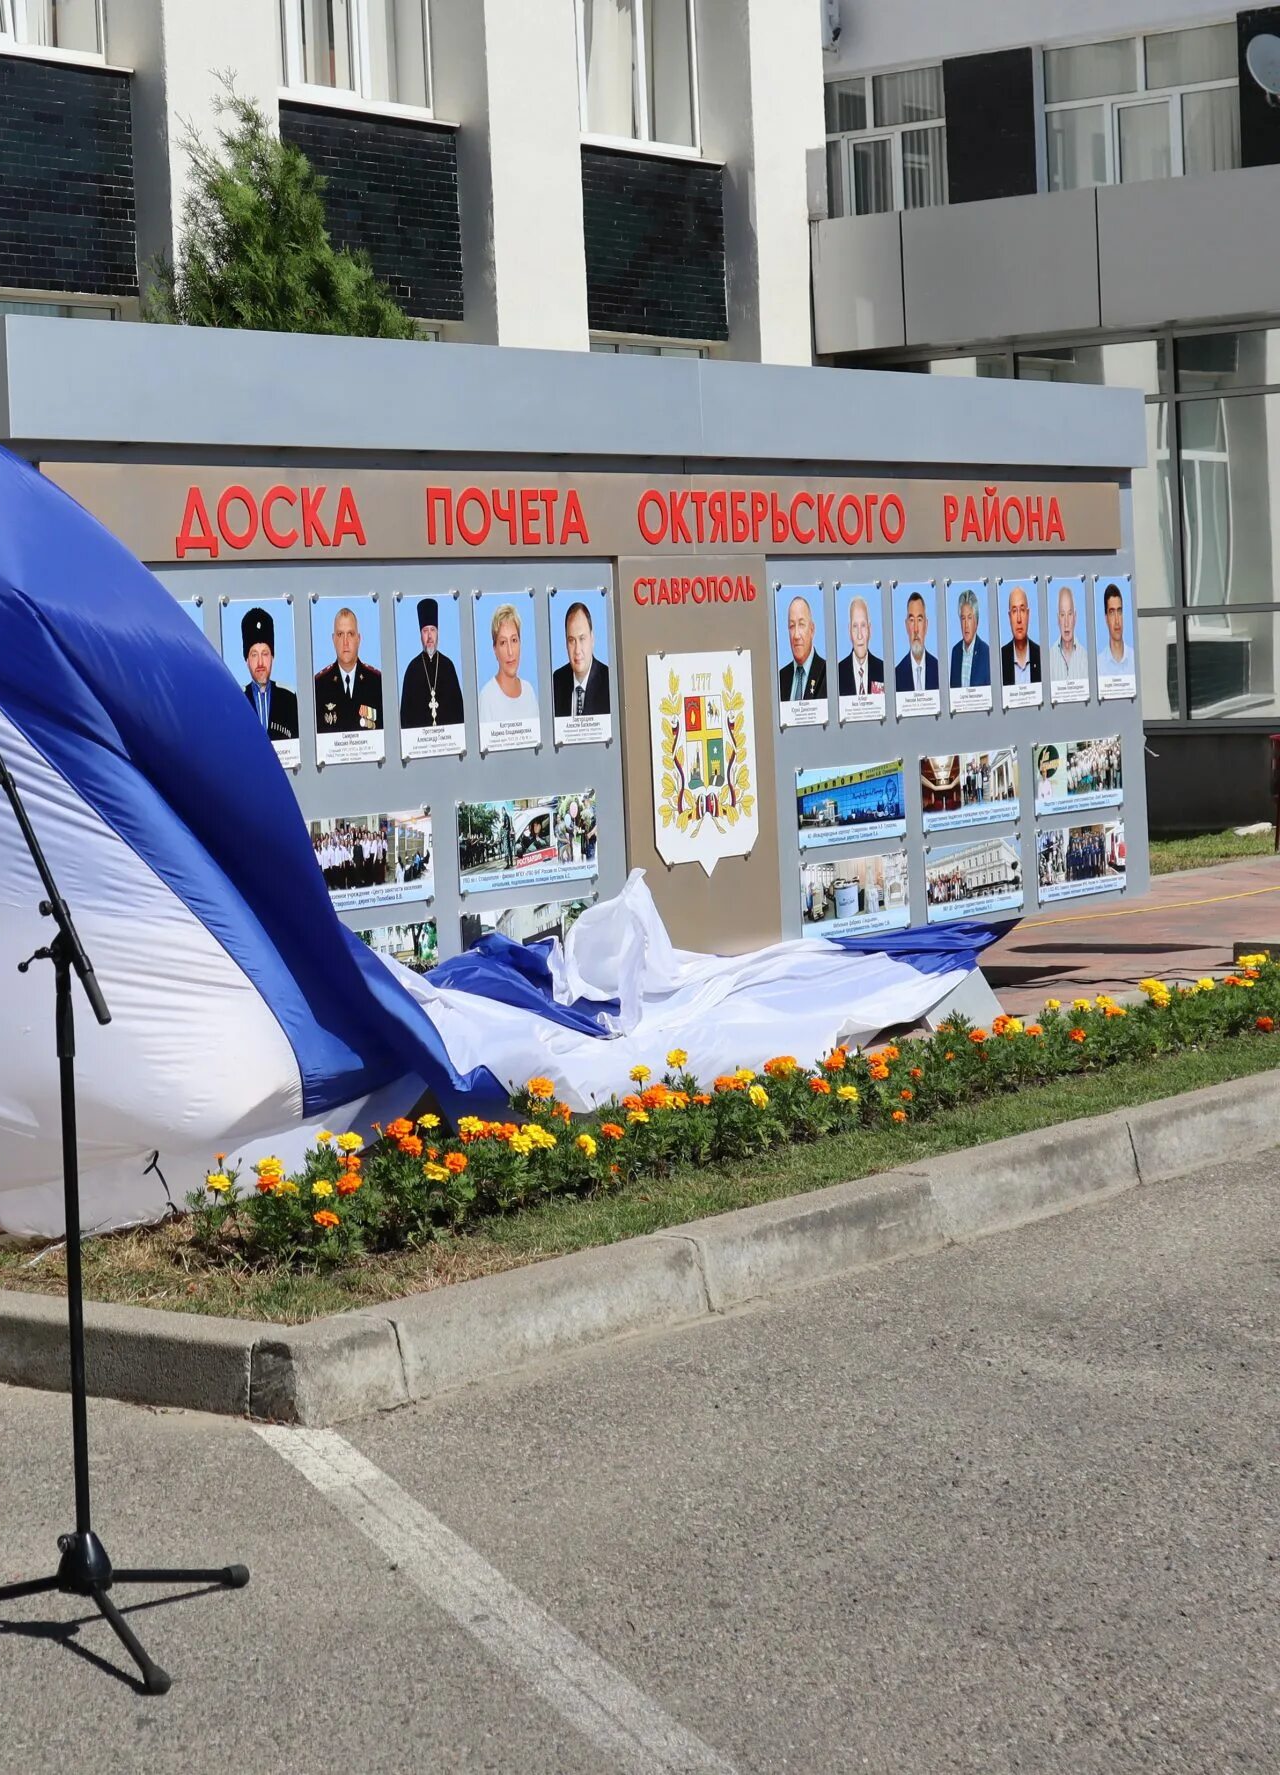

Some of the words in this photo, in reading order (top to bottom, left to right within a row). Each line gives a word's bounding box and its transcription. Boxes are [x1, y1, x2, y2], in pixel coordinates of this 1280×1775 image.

[175, 484, 368, 558] ДОСКА
[425, 486, 590, 546] ПОЧЕТА
[637, 488, 907, 546] ОКТЯБРЬСКОГО
[943, 484, 1066, 545] РАЙОНА
[632, 574, 757, 606] СТАВРОПОЛЬ
[691, 672, 712, 692] 1777
